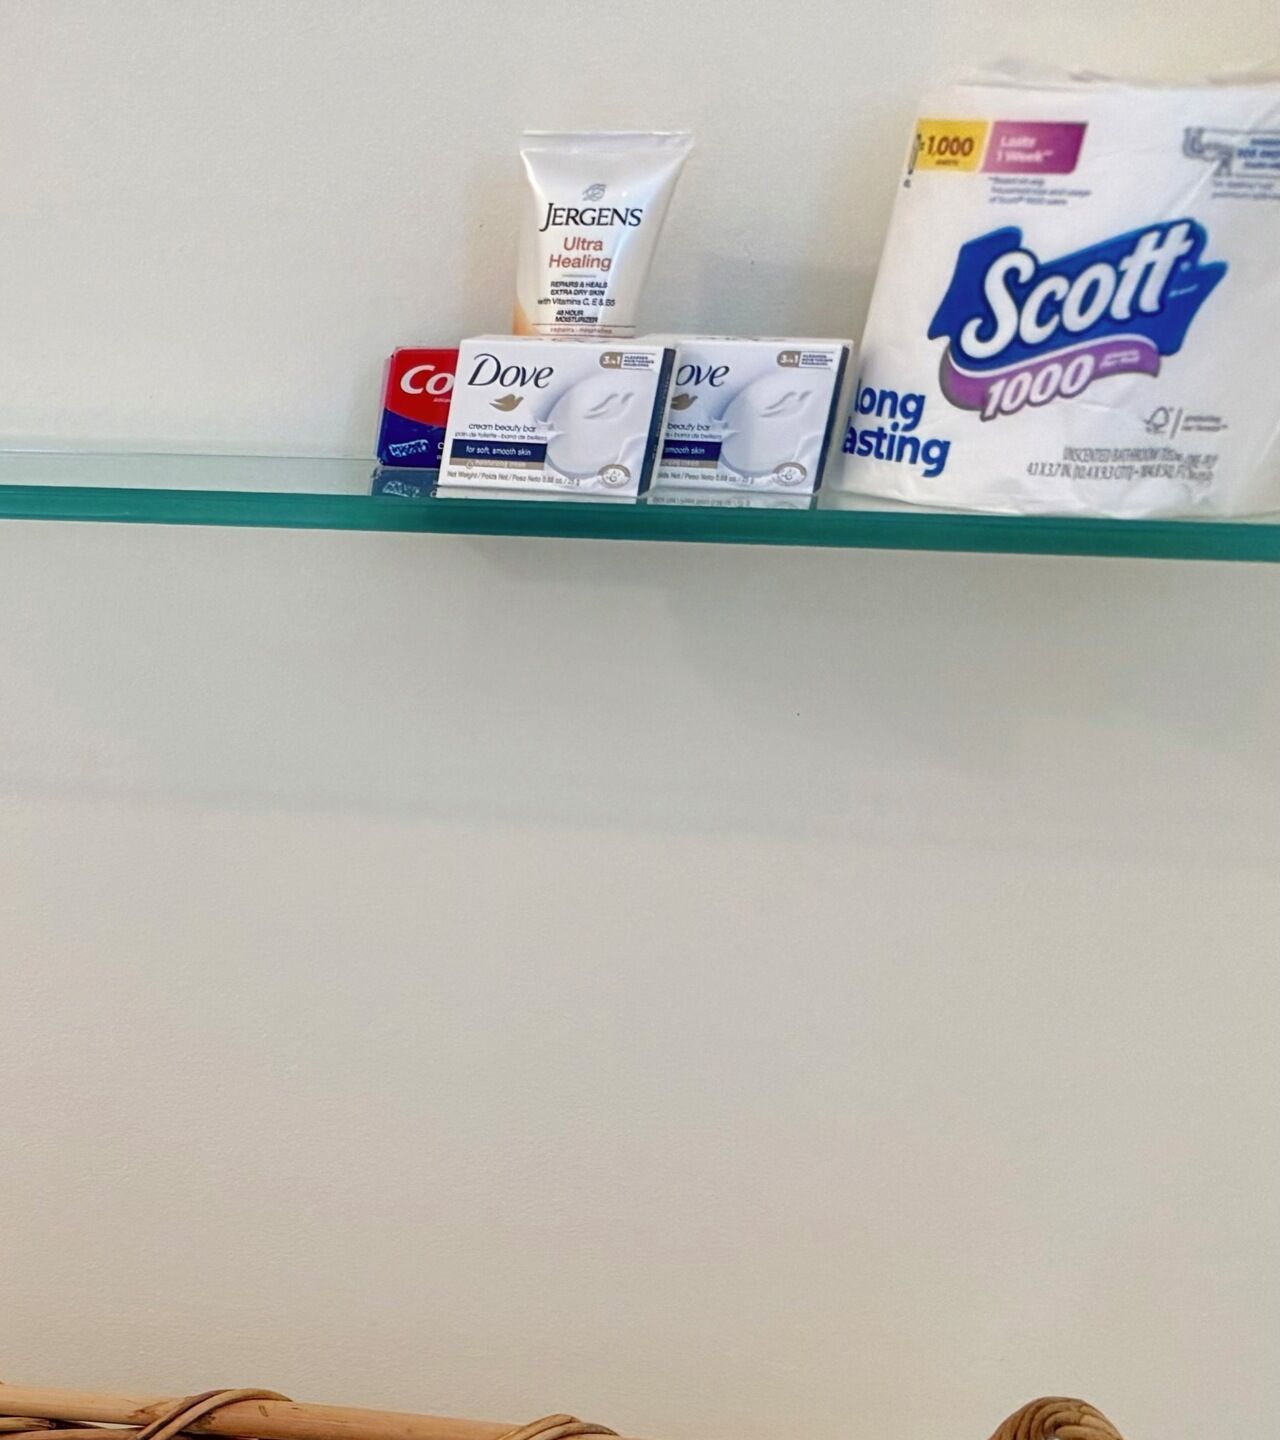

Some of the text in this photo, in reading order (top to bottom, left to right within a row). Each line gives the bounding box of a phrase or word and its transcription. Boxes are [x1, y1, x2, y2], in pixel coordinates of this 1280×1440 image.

[539, 202, 643, 232] JERGENS
[563, 236, 603, 251] Ultra
[549, 254, 612, 272] Healing
[585, 281, 608, 289] HEALS
[960, 221, 1194, 359] Scott
[400, 364, 456, 396] Co
[467, 353, 554, 389] Dove
[675, 364, 730, 388] ove
[983, 354, 1096, 419] 1000
[468, 423, 536, 433] cream beauty bar
[492, 447, 516, 455] smooth
[517, 448, 532, 456] skin
[690, 447, 705, 455] skin
